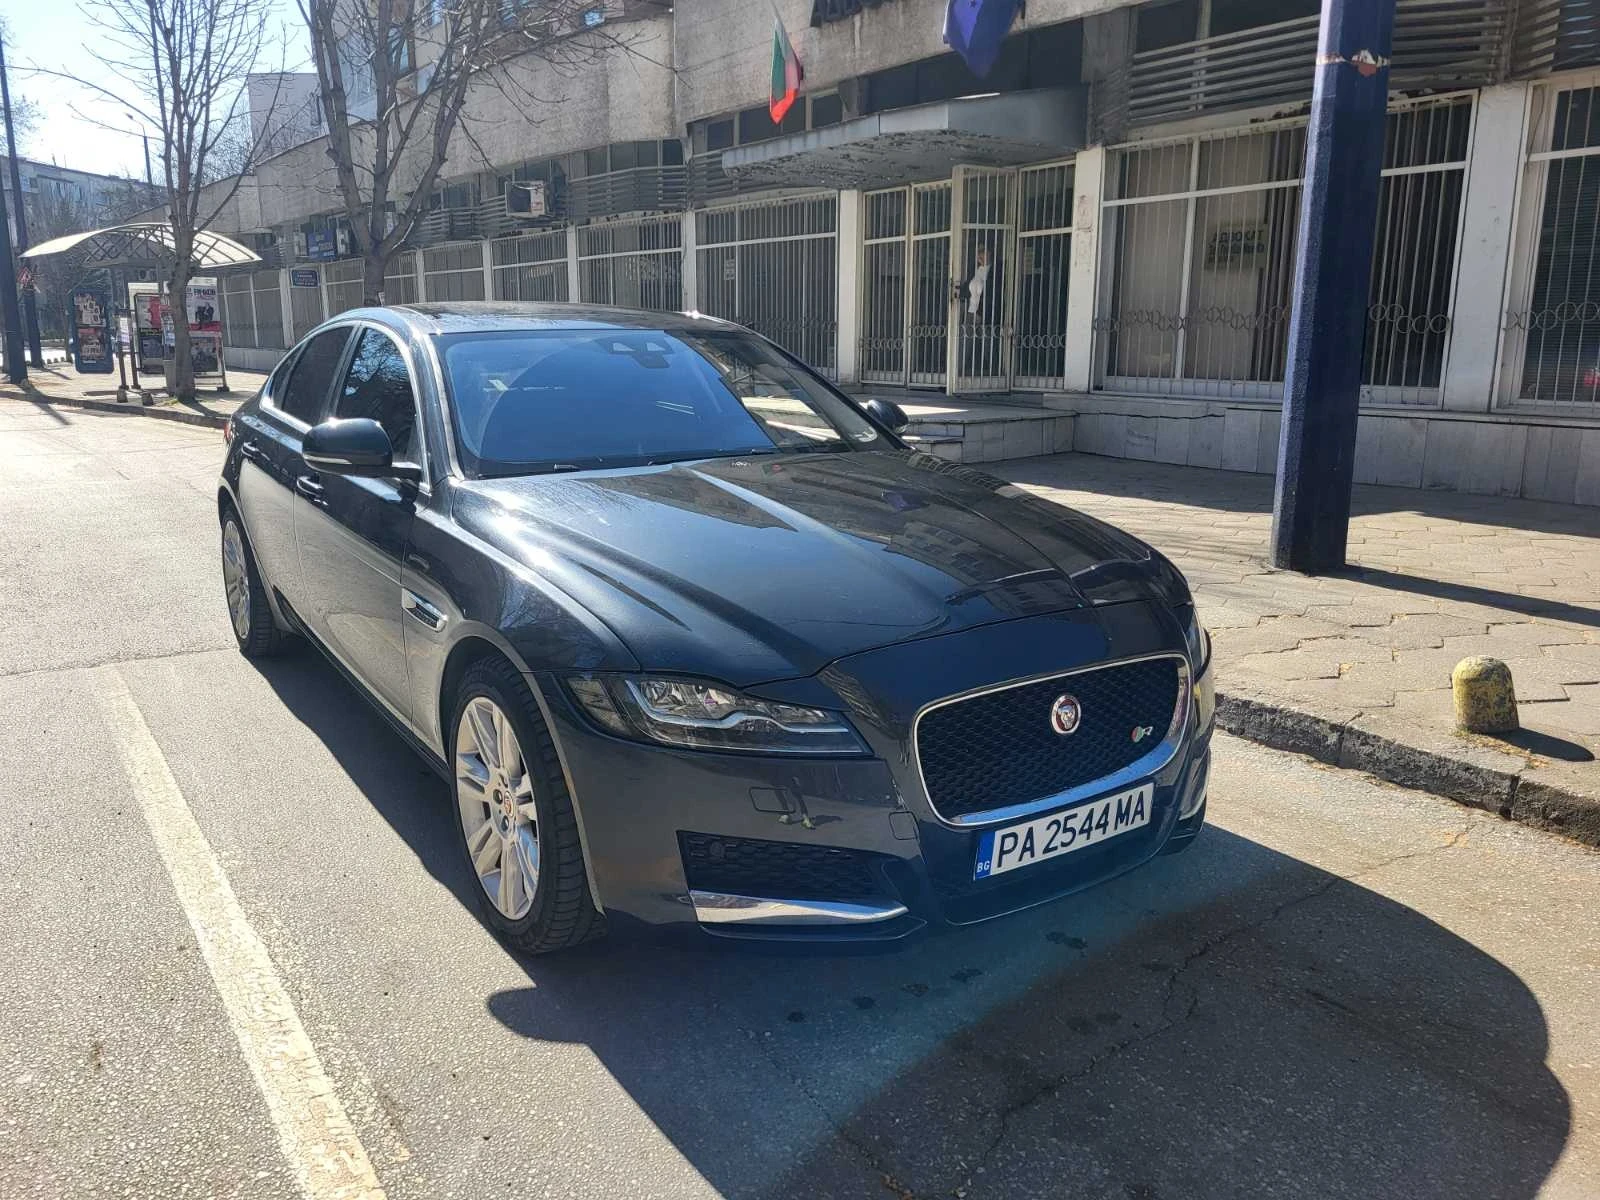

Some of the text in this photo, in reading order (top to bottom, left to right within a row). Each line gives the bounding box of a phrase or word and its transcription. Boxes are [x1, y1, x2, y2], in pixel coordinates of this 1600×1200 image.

[997, 790, 1146, 868] PA 2544 MA
[976, 860, 991, 873] BG
